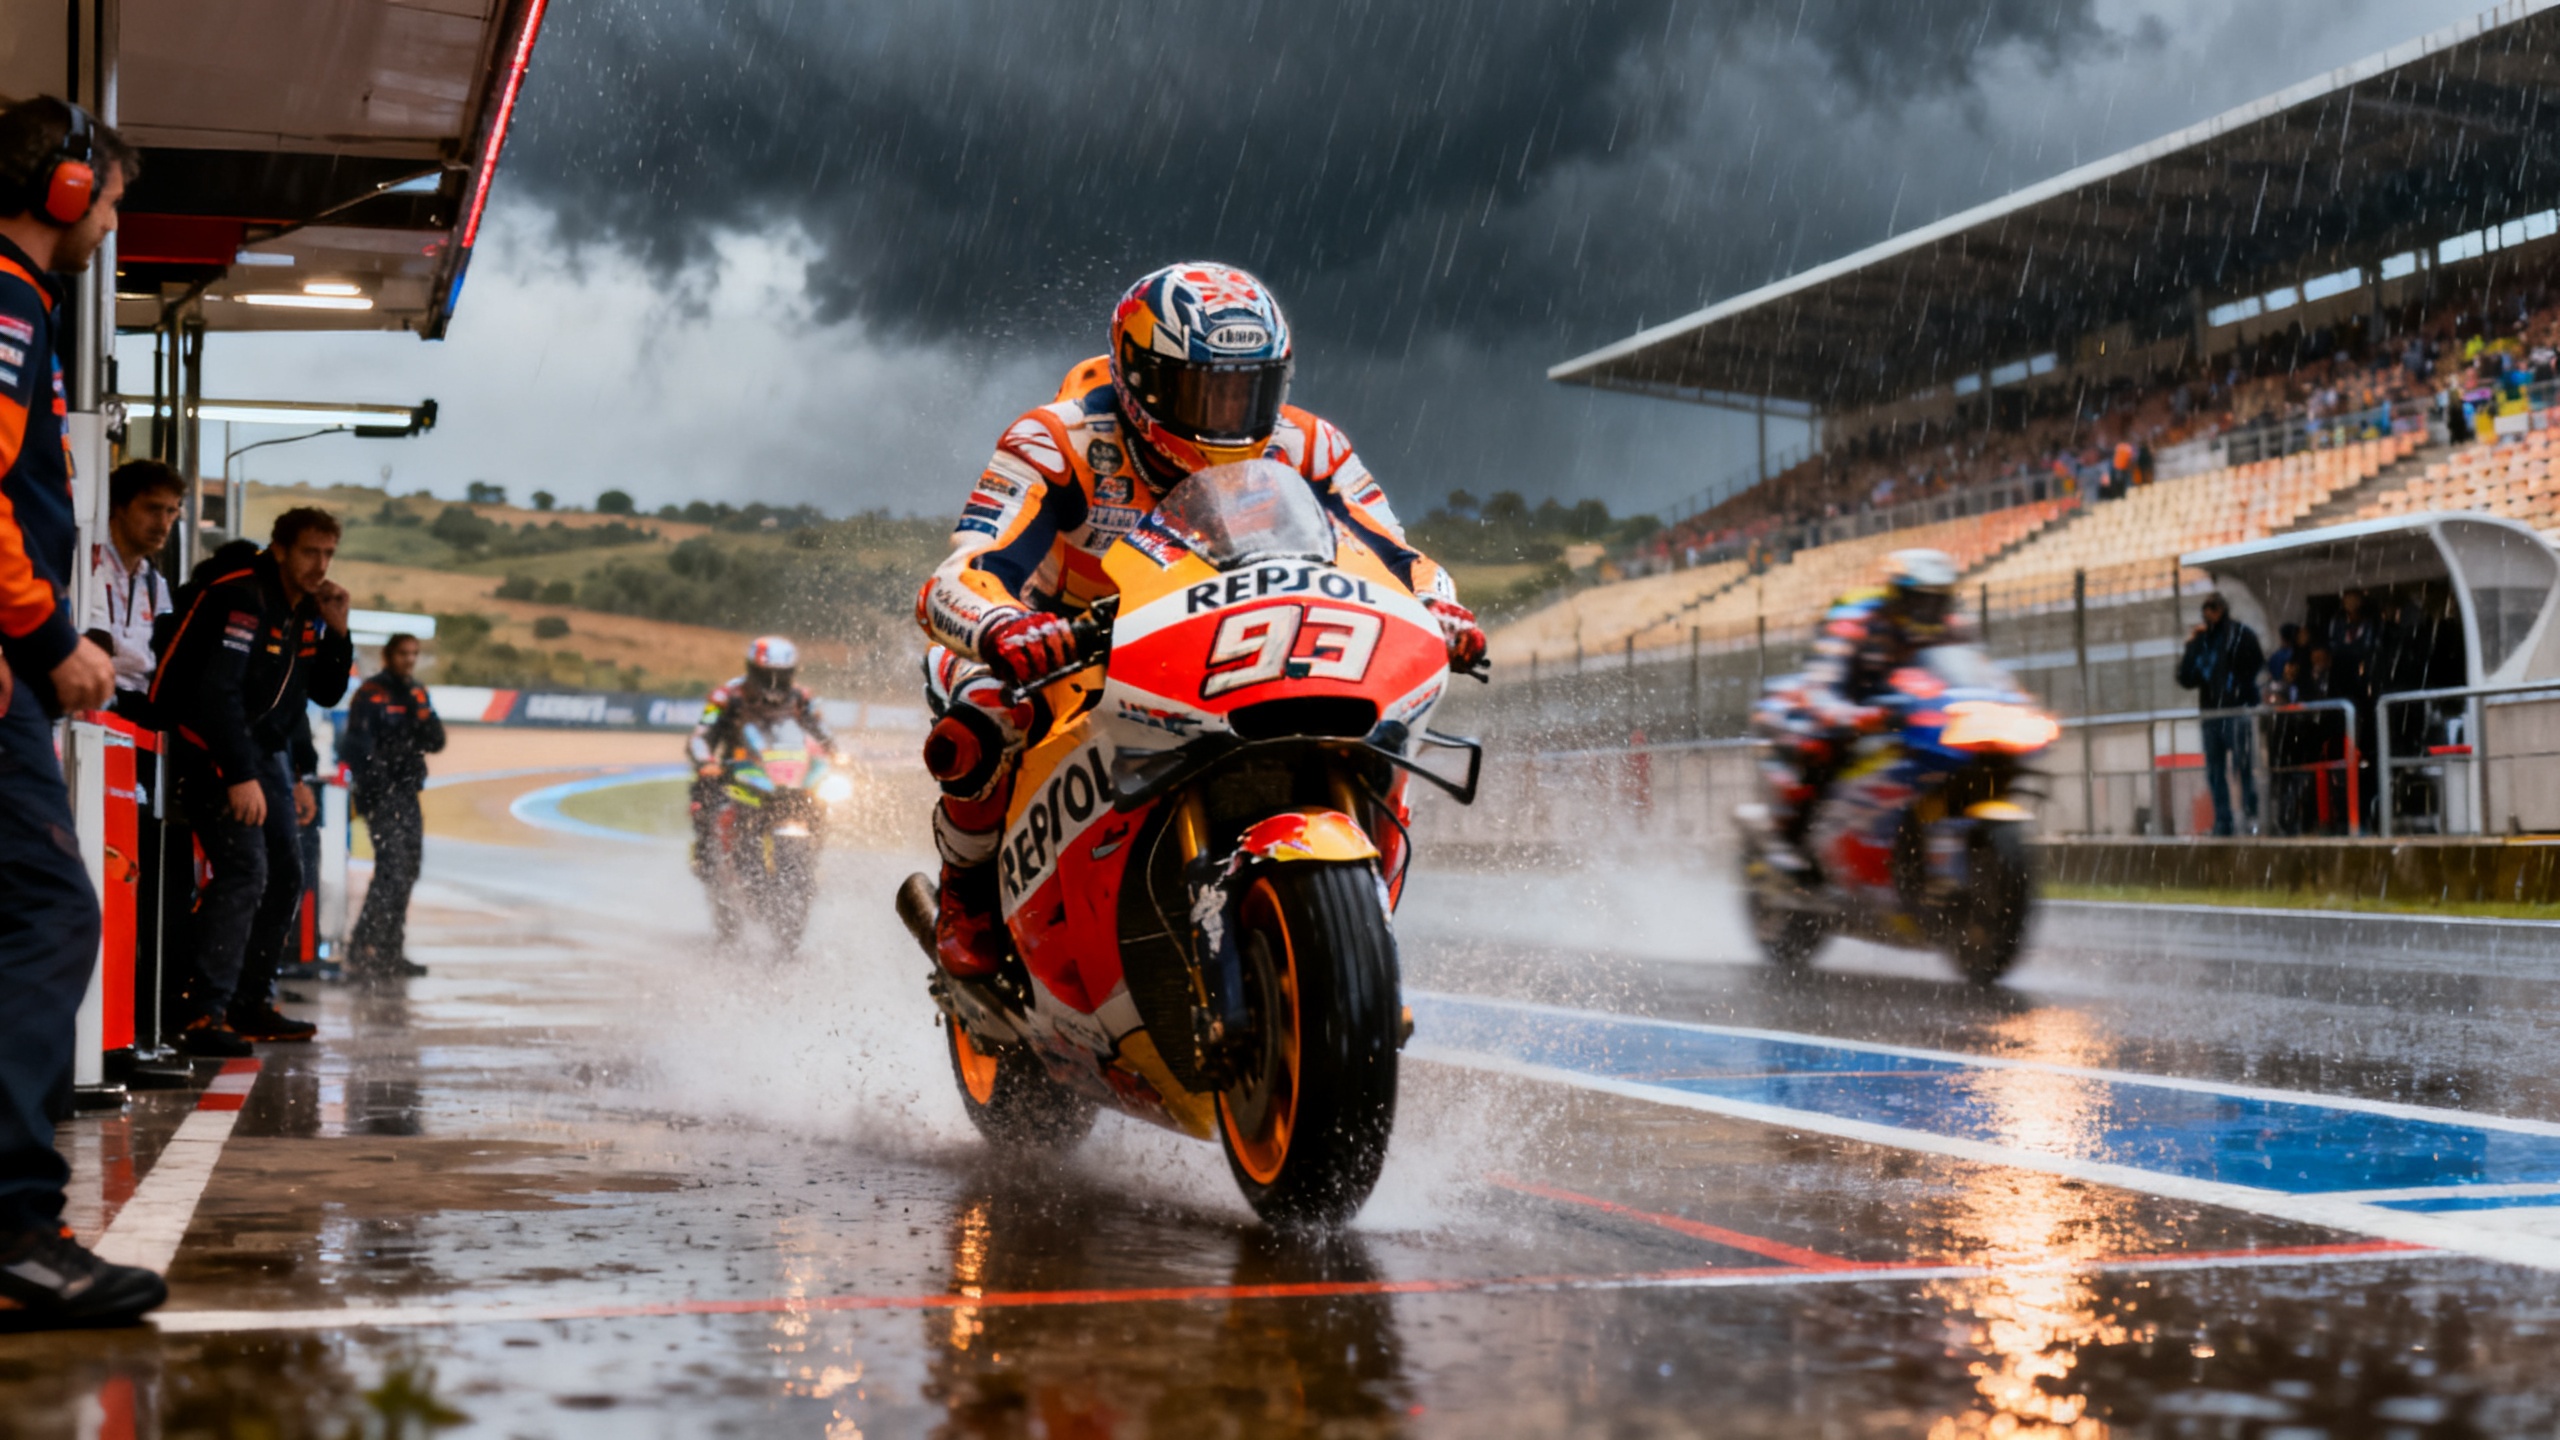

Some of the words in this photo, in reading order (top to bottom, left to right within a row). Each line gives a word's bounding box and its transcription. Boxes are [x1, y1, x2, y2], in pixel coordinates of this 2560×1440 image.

[1187, 566, 1376, 613] REPSOL
[1199, 604, 1385, 701] 93
[1002, 746, 1115, 899] REPSOL
